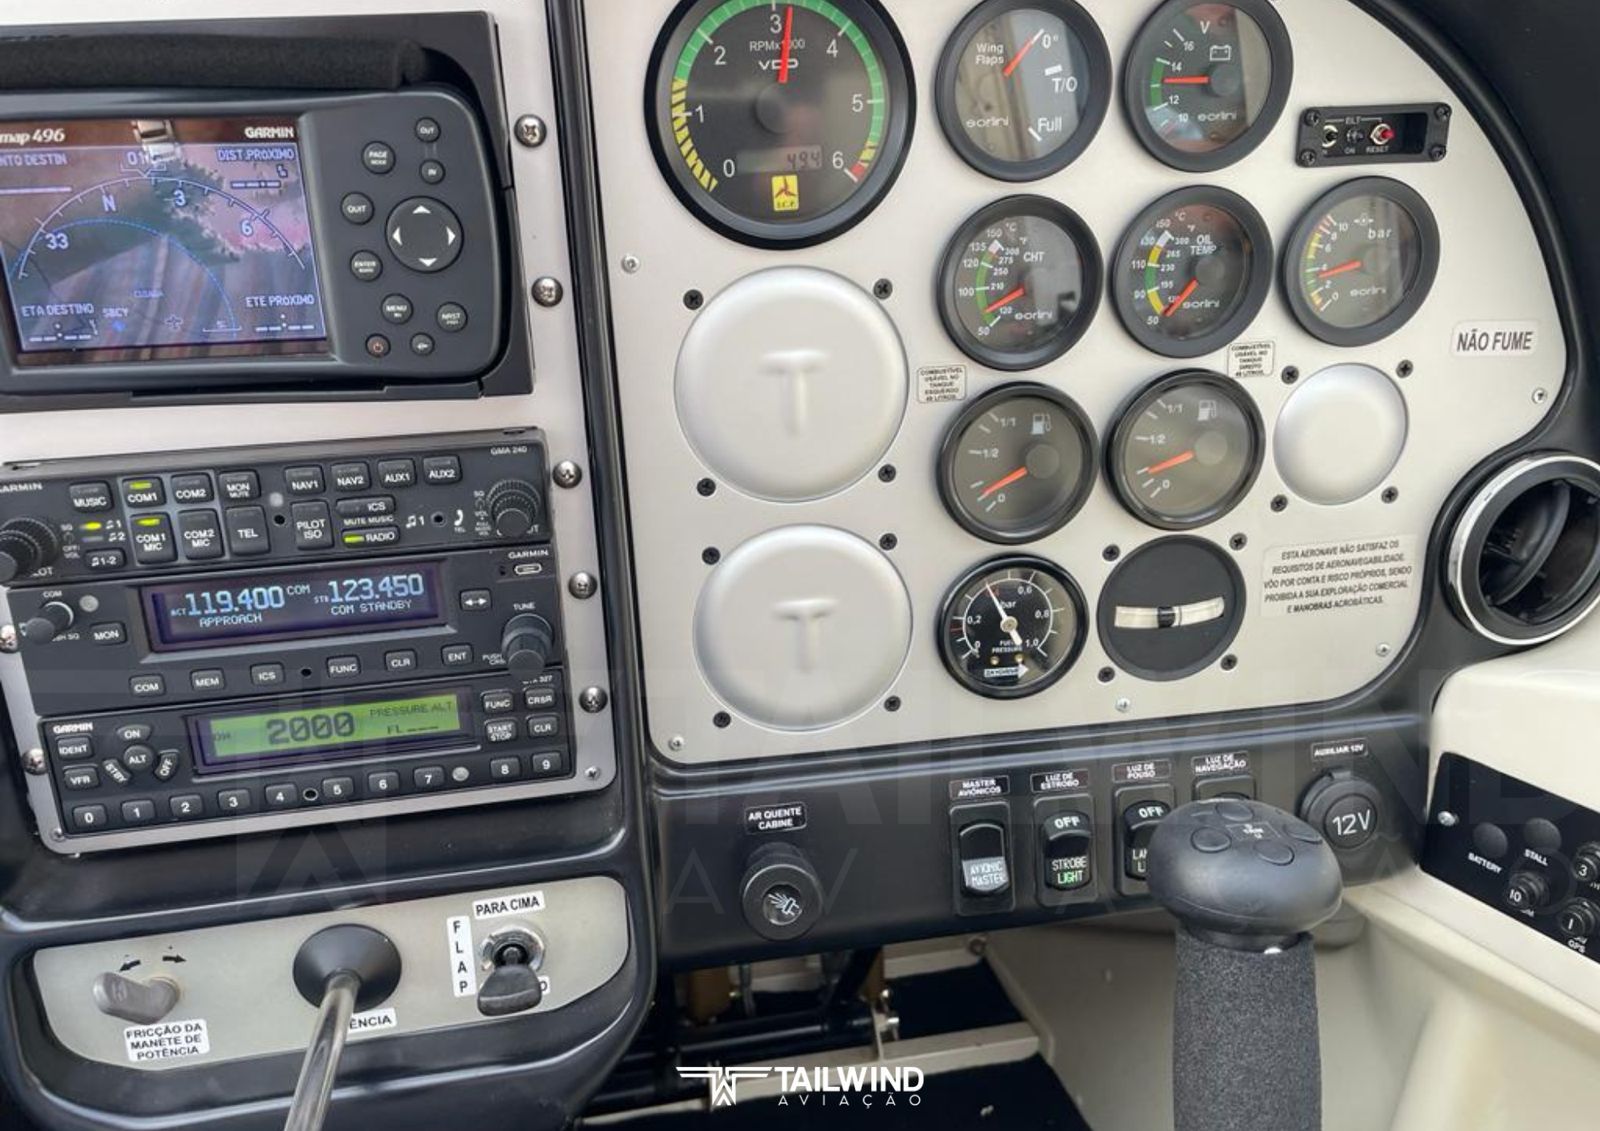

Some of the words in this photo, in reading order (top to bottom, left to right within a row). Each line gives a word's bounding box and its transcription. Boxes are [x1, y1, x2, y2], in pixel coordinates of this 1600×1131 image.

[770, 15, 782, 34] 3
[1200, 21, 1210, 34] V
[826, 41, 838, 57] 4
[976, 43, 1004, 54] Wing
[1184, 41, 1195, 51] 16
[714, 46, 726, 65] 2
[976, 55, 1005, 66] Flaps
[1171, 62, 1182, 72] 14
[1052, 76, 1078, 93] T/O
[851, 94, 864, 112] 5
[1169, 95, 1180, 105] 12
[695, 106, 704, 123] 1
[1178, 114, 1189, 122] 10
[1037, 116, 1062, 132] Full
[32, 127, 66, 143] 496
[244, 126, 295, 139] GARMIN
[832, 151, 844, 170] 6
[723, 159, 735, 178] 0
[102, 195, 117, 212] N
[173, 189, 187, 206] 3
[347, 204, 367, 214] QUIT
[242, 220, 253, 236] 6
[1338, 222, 1349, 232] 10
[1196, 234, 1214, 245] OIL
[1367, 228, 1392, 240] bar
[46, 233, 69, 249] 33
[1190, 245, 1217, 256] TEMP
[1023, 251, 1045, 263] CHT
[963, 258, 979, 269] 120
[1131, 260, 1147, 270] 110
[958, 286, 975, 297] 100
[246, 297, 267, 308] ETE
[21, 305, 45, 317] ETA
[46, 303, 95, 316] DESTINO
[1147, 315, 1160, 326] 50
[978, 325, 990, 336] 50
[1456, 328, 1490, 351] NÃO
[1491, 331, 1534, 351] FUME
[984, 448, 1000, 458] 1/2
[384, 473, 411, 484] AUX1
[429, 469, 456, 480] AUX2
[226, 482, 251, 492] MON
[291, 480, 319, 490] NAV1
[337, 475, 364, 487] NAV2
[1162, 479, 1170, 489] 0
[127, 492, 158, 503] COM1
[175, 488, 207, 500] COM2
[998, 494, 1006, 502] 0
[73, 497, 107, 508] MUSIC
[367, 501, 386, 512] ICS
[297, 518, 326, 530] PILOT
[344, 517, 367, 526] MUTE
[368, 515, 394, 524] MUSIC
[136, 532, 166, 544] COM1
[184, 529, 215, 540] COM2
[237, 528, 259, 539] TEL
[303, 529, 323, 540] ISO
[365, 531, 395, 543] RADIO
[143, 542, 163, 552] MIC
[191, 538, 211, 548] MIC
[508, 549, 549, 560] GARMIN
[43, 590, 62, 598] COM
[287, 584, 311, 596] COM
[328, 573, 425, 603] 123.450
[185, 585, 286, 616] 119.400
[513, 602, 536, 611] TUNE
[330, 604, 354, 616] COM
[360, 598, 413, 613] STANDBY
[200, 613, 263, 628] APPROACH
[93, 629, 120, 640] MON
[390, 657, 412, 668] CLR
[448, 651, 468, 662] ENT
[329, 663, 358, 675] FUNC
[195, 677, 220, 687] MEM
[258, 671, 277, 681] ICS
[134, 683, 160, 693] COM
[369, 701, 429, 717] PRESSURE
[484, 699, 512, 710] FUNC
[53, 722, 94, 734] GARMIN
[266, 711, 356, 746] 2000
[487, 723, 513, 733] START
[534, 722, 552, 733] CLR
[124, 729, 140, 739] ON
[490, 732, 512, 742] STOP
[58, 745, 88, 755] IDENT
[128, 754, 147, 765] ALT
[542, 758, 551, 771] 9
[104, 763, 127, 784] STBY
[159, 759, 174, 777] OFF
[501, 763, 510, 776] 8
[1126, 765, 1143, 773] LUZ
[1144, 763, 1155, 771] DE
[70, 775, 91, 785] VFR
[424, 773, 433, 785] 7
[1045, 774, 1061, 783] LUZ
[1062, 772, 1073, 781] DE
[333, 783, 342, 796] 5
[378, 778, 388, 791] 6
[962, 779, 996, 789] MASTER
[229, 796, 239, 809] 3
[275, 791, 285, 803] 4
[134, 807, 141, 819] 1
[181, 802, 191, 814] 2
[748, 810, 763, 821] AR
[764, 806, 802, 819] QUENTE
[1138, 806, 1164, 819] OFF
[84, 811, 94, 824] 0
[1054, 816, 1081, 829] OFF
[1332, 809, 1371, 836] 12V
[758, 818, 793, 830] CABINE
[1052, 855, 1088, 871] STROBE
[1468, 852, 1502, 874] BATTERY
[1524, 848, 1549, 867] STALL
[1578, 864, 1588, 877] 3
[1057, 870, 1084, 884] LIGHT
[1509, 888, 1522, 903] 10
[475, 902, 508, 917] PARA
[510, 896, 540, 911] CIMA
[126, 1023, 183, 1040] FRICÇÃO
[184, 1021, 203, 1033] DA
[130, 1036, 182, 1050] MANETE
[184, 1033, 202, 1044] DE
[137, 1044, 200, 1061] POTÊNCIA
